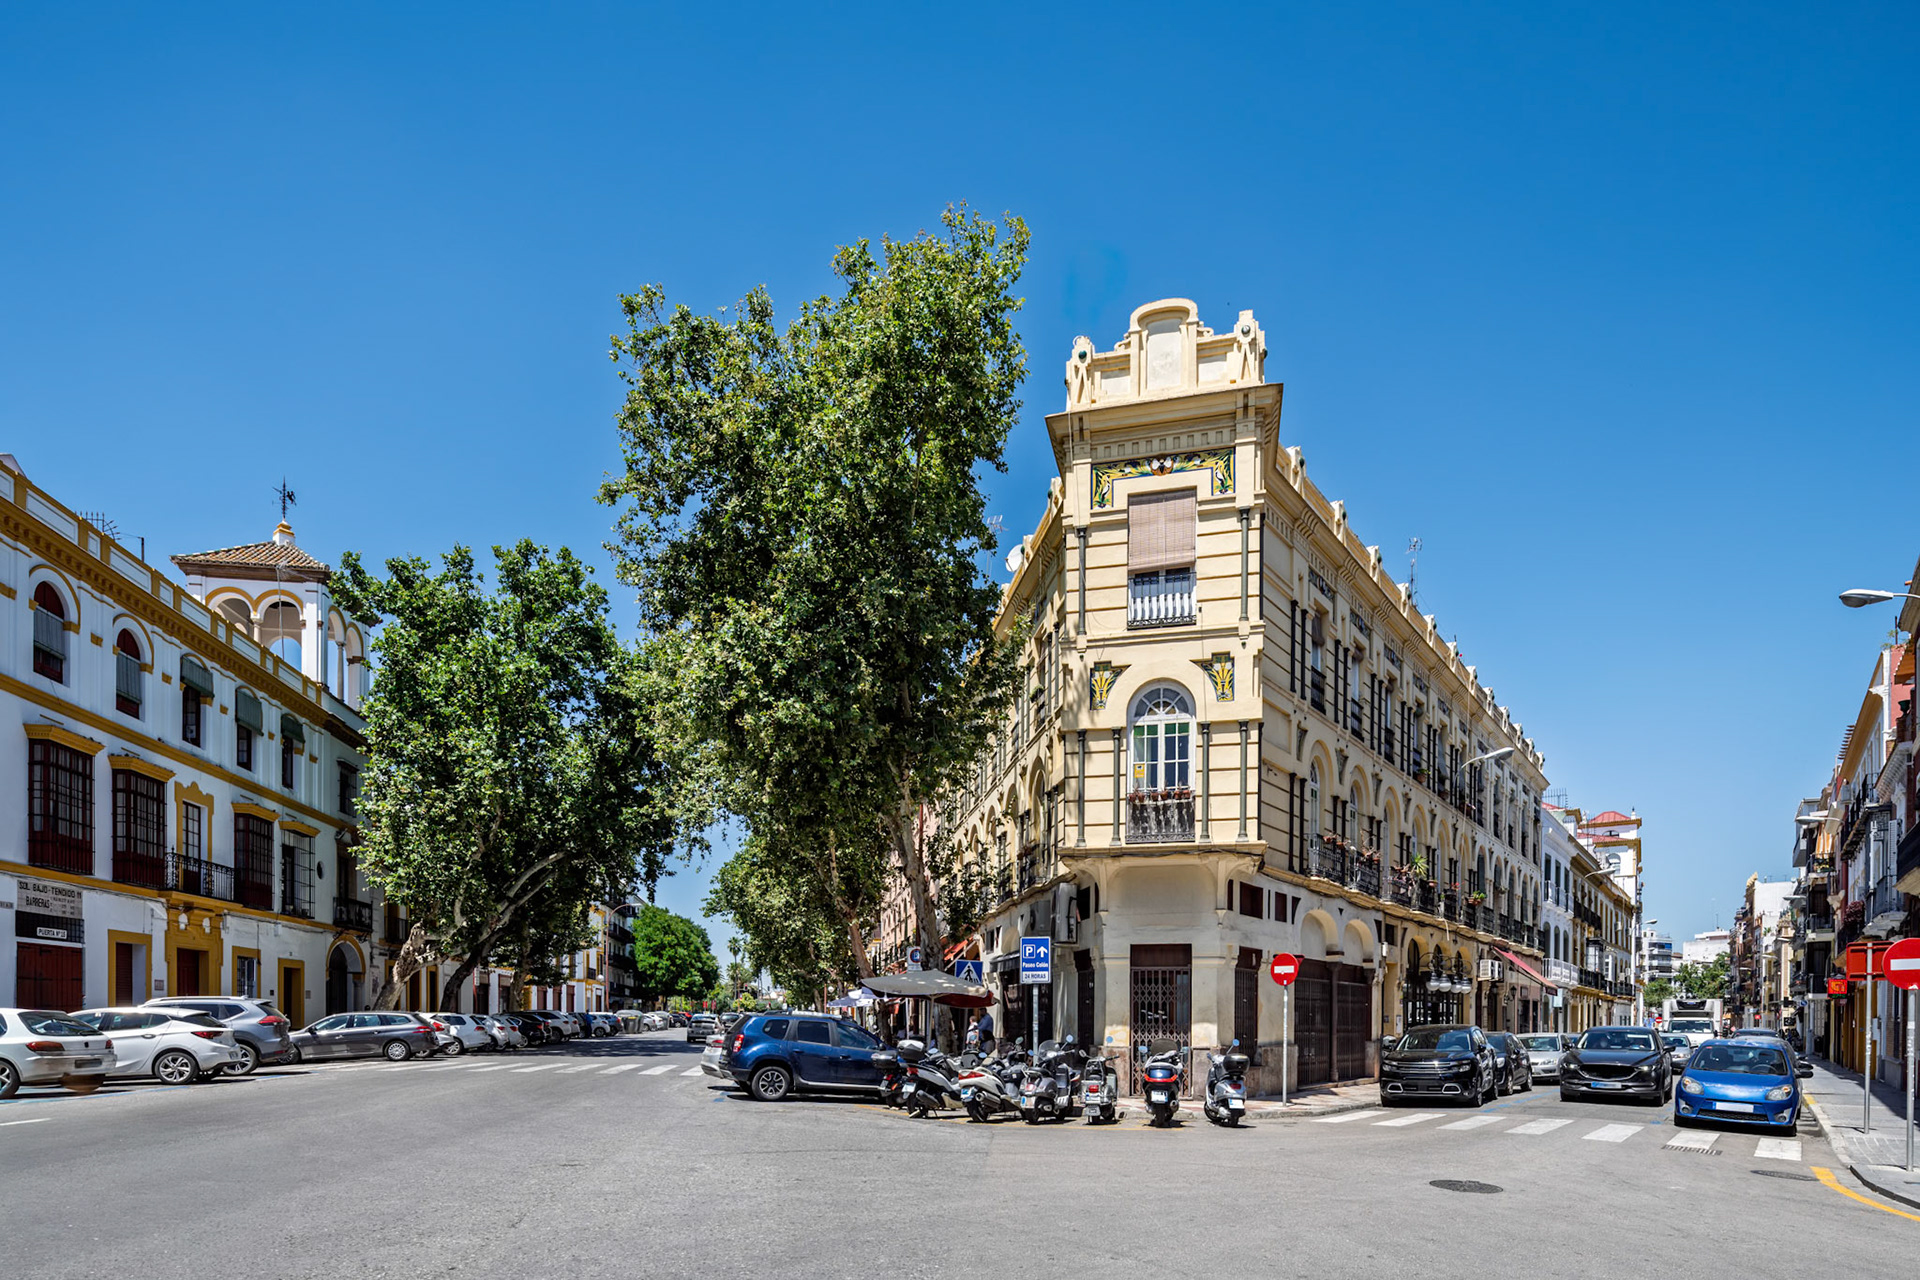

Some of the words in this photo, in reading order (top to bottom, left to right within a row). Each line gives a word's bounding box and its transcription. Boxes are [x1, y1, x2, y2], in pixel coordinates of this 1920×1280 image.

[19, 881, 30, 890] SOL
[26, 896, 50, 908] BARRERAS
[38, 928, 55, 936] PUERTA
[1026, 947, 1033, 957] P
